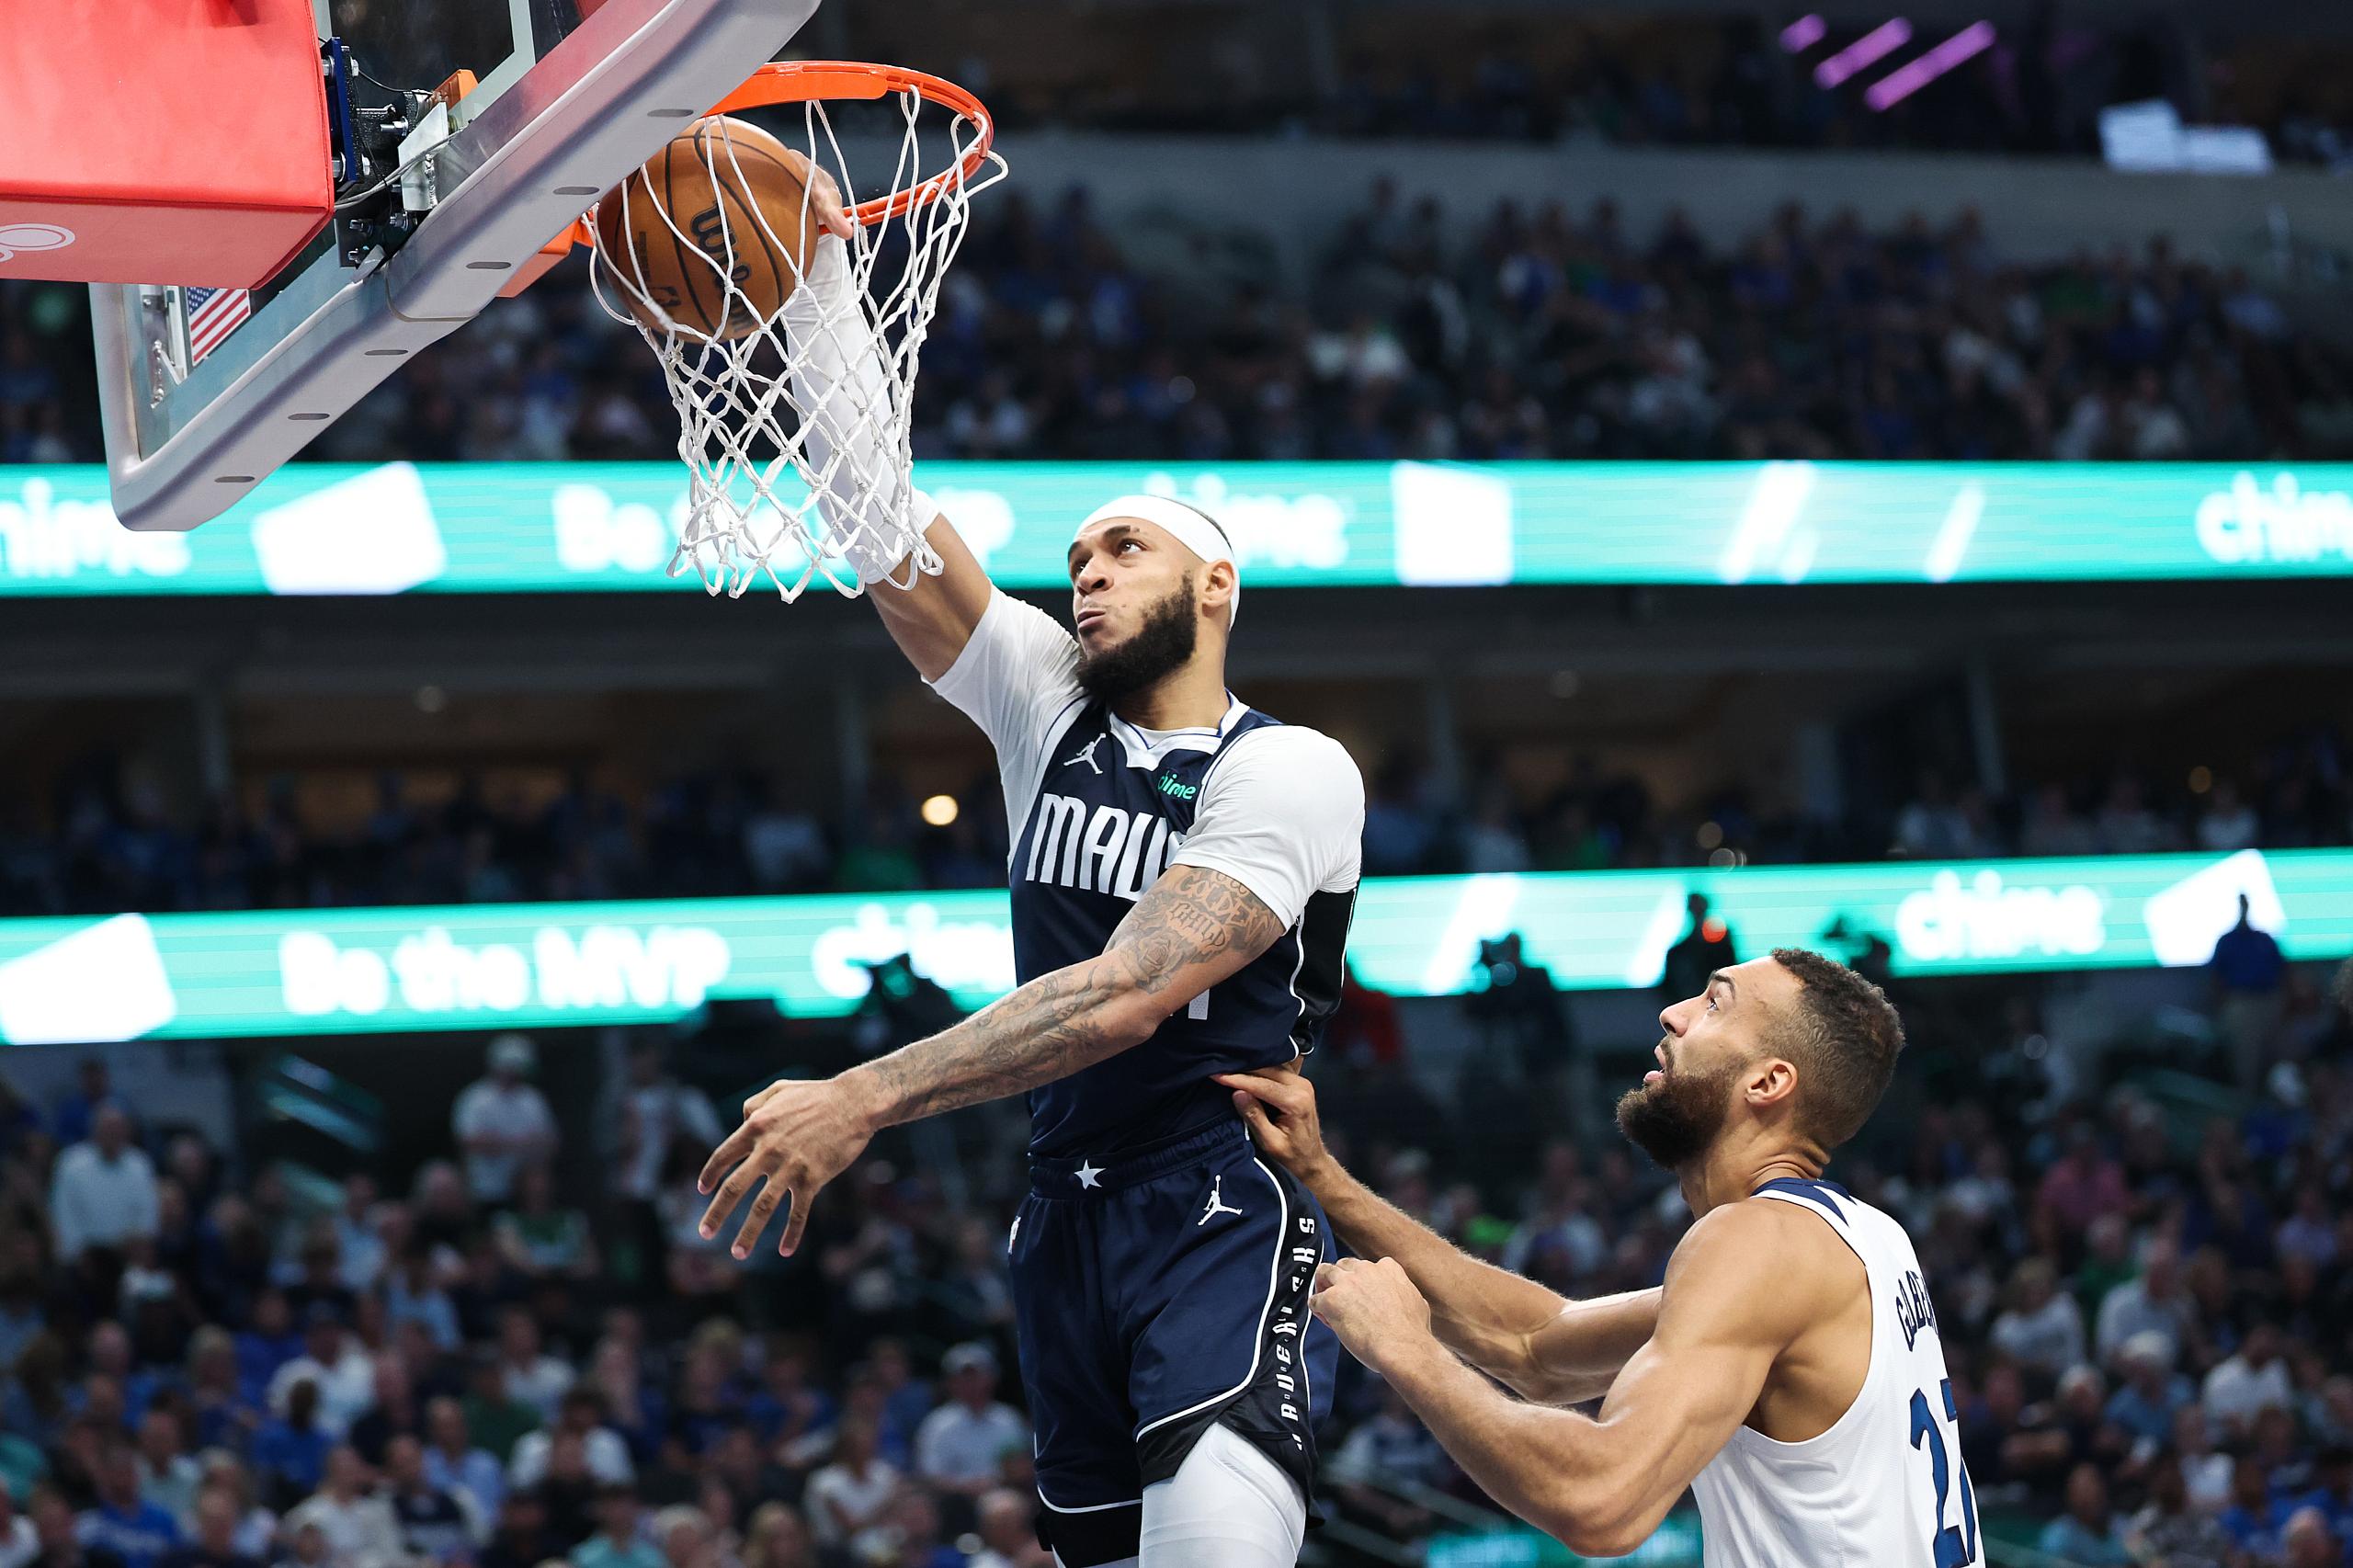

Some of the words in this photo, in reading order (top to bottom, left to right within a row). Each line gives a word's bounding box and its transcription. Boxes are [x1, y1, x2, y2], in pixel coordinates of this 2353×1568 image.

[553, 483, 667, 570] Be
[2196, 471, 2353, 562] chim
[278, 930, 391, 1015] Be
[392, 926, 531, 1010] the
[533, 923, 733, 1006] MVP
